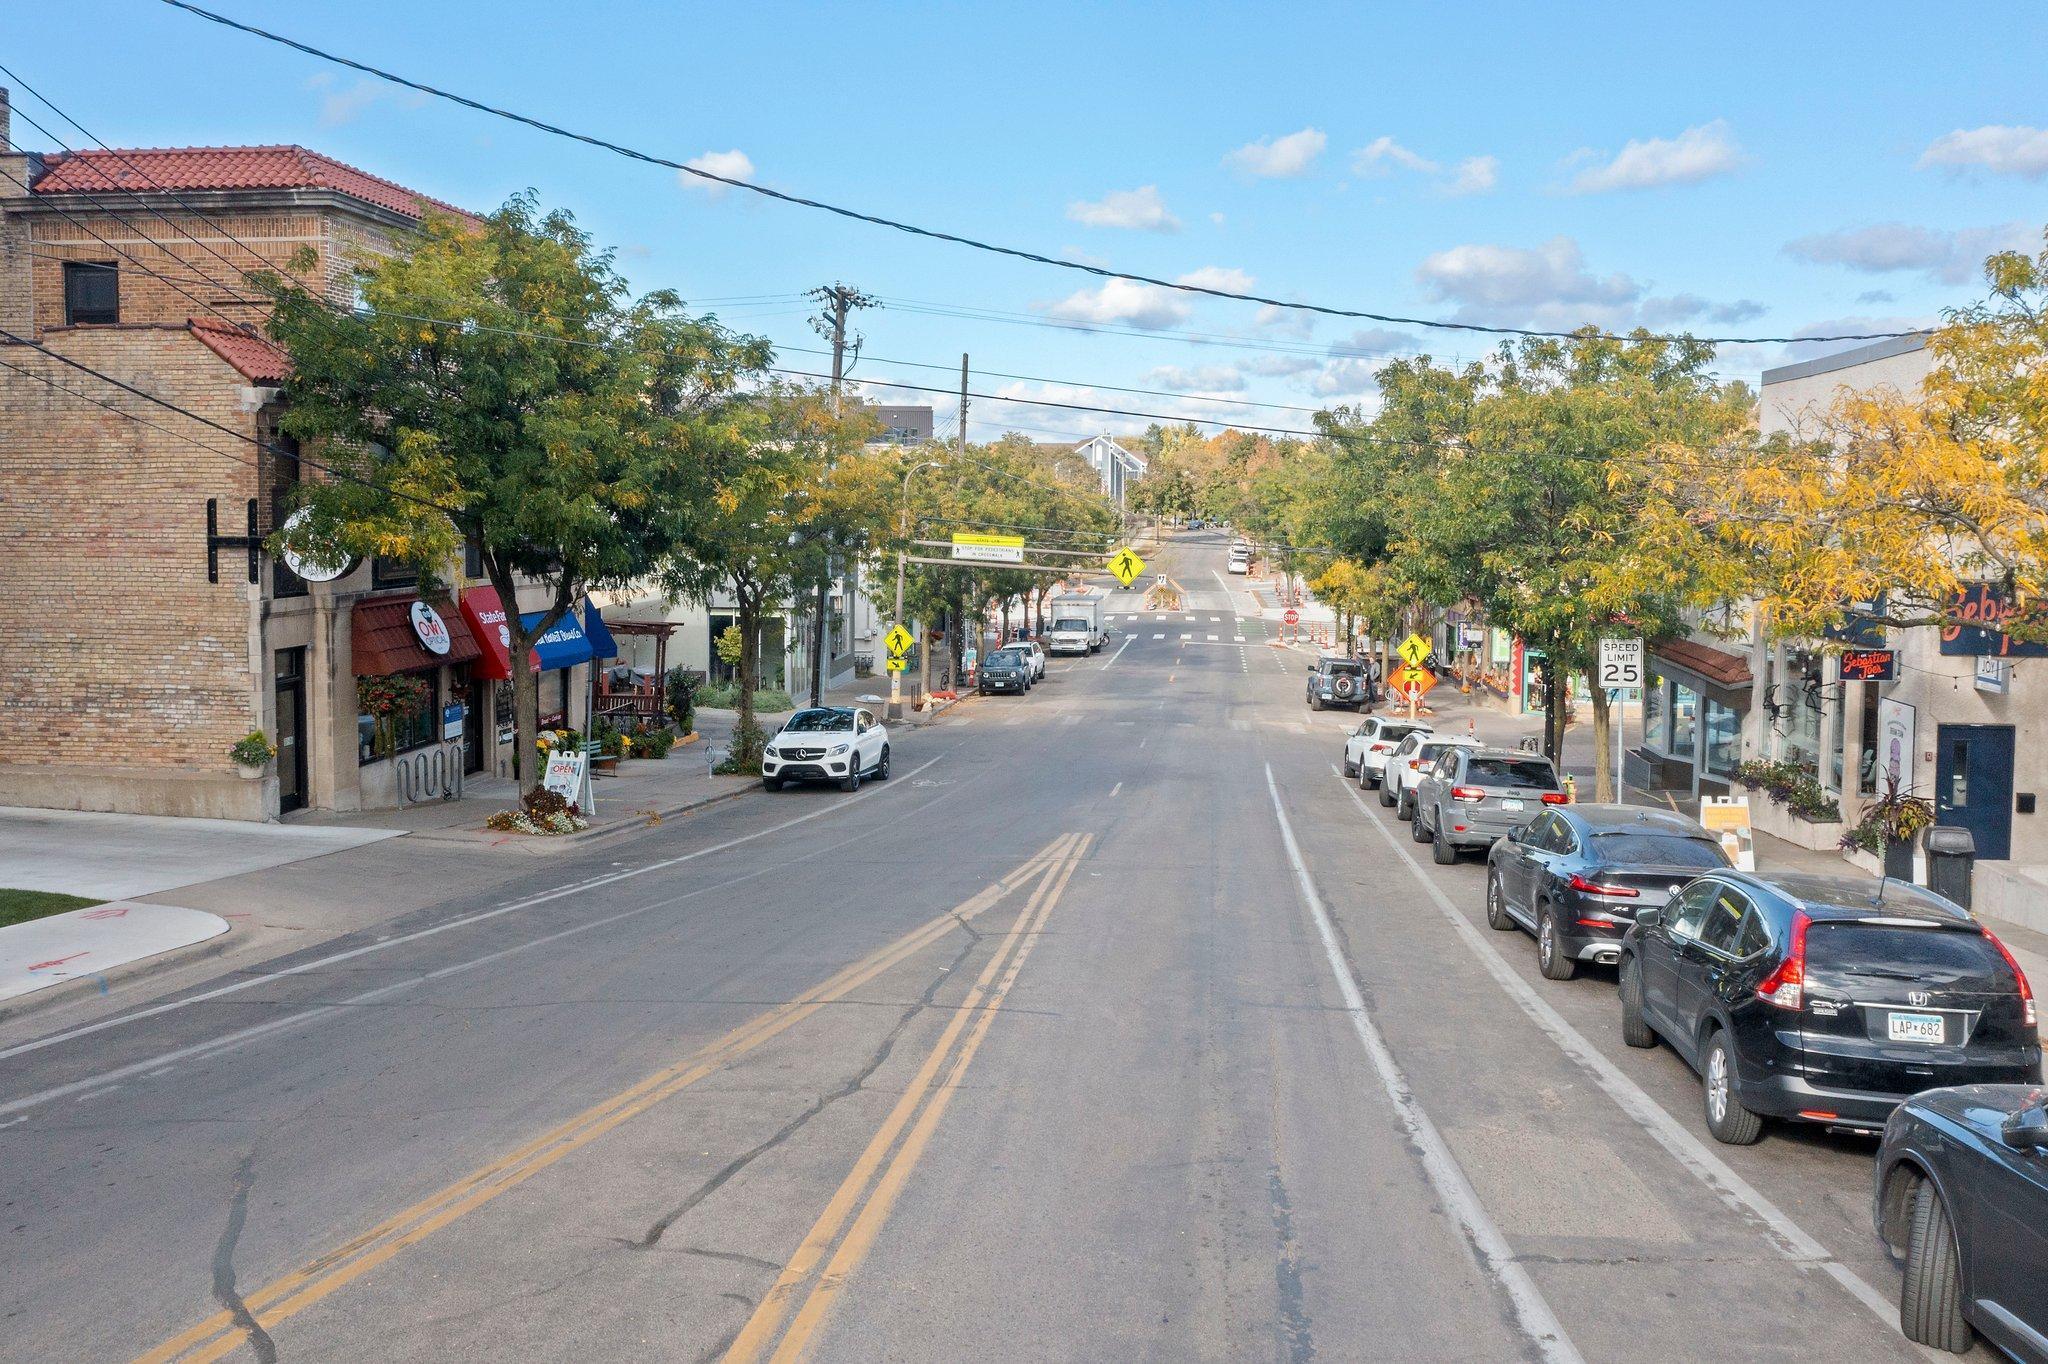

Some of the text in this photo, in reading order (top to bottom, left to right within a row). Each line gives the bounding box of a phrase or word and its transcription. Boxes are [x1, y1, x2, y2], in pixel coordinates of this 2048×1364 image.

[1284, 613, 1299, 621] STOP
[1604, 644, 1639, 652] SPEED
[1607, 654, 1634, 662] LIMIT
[1843, 652, 1891, 672] Sebastian
[1982, 660, 1995, 674] JOY
[1604, 664, 1638, 682] 25
[553, 765, 575, 773] OPEN
[1892, 1021, 1940, 1036] LAP 682
